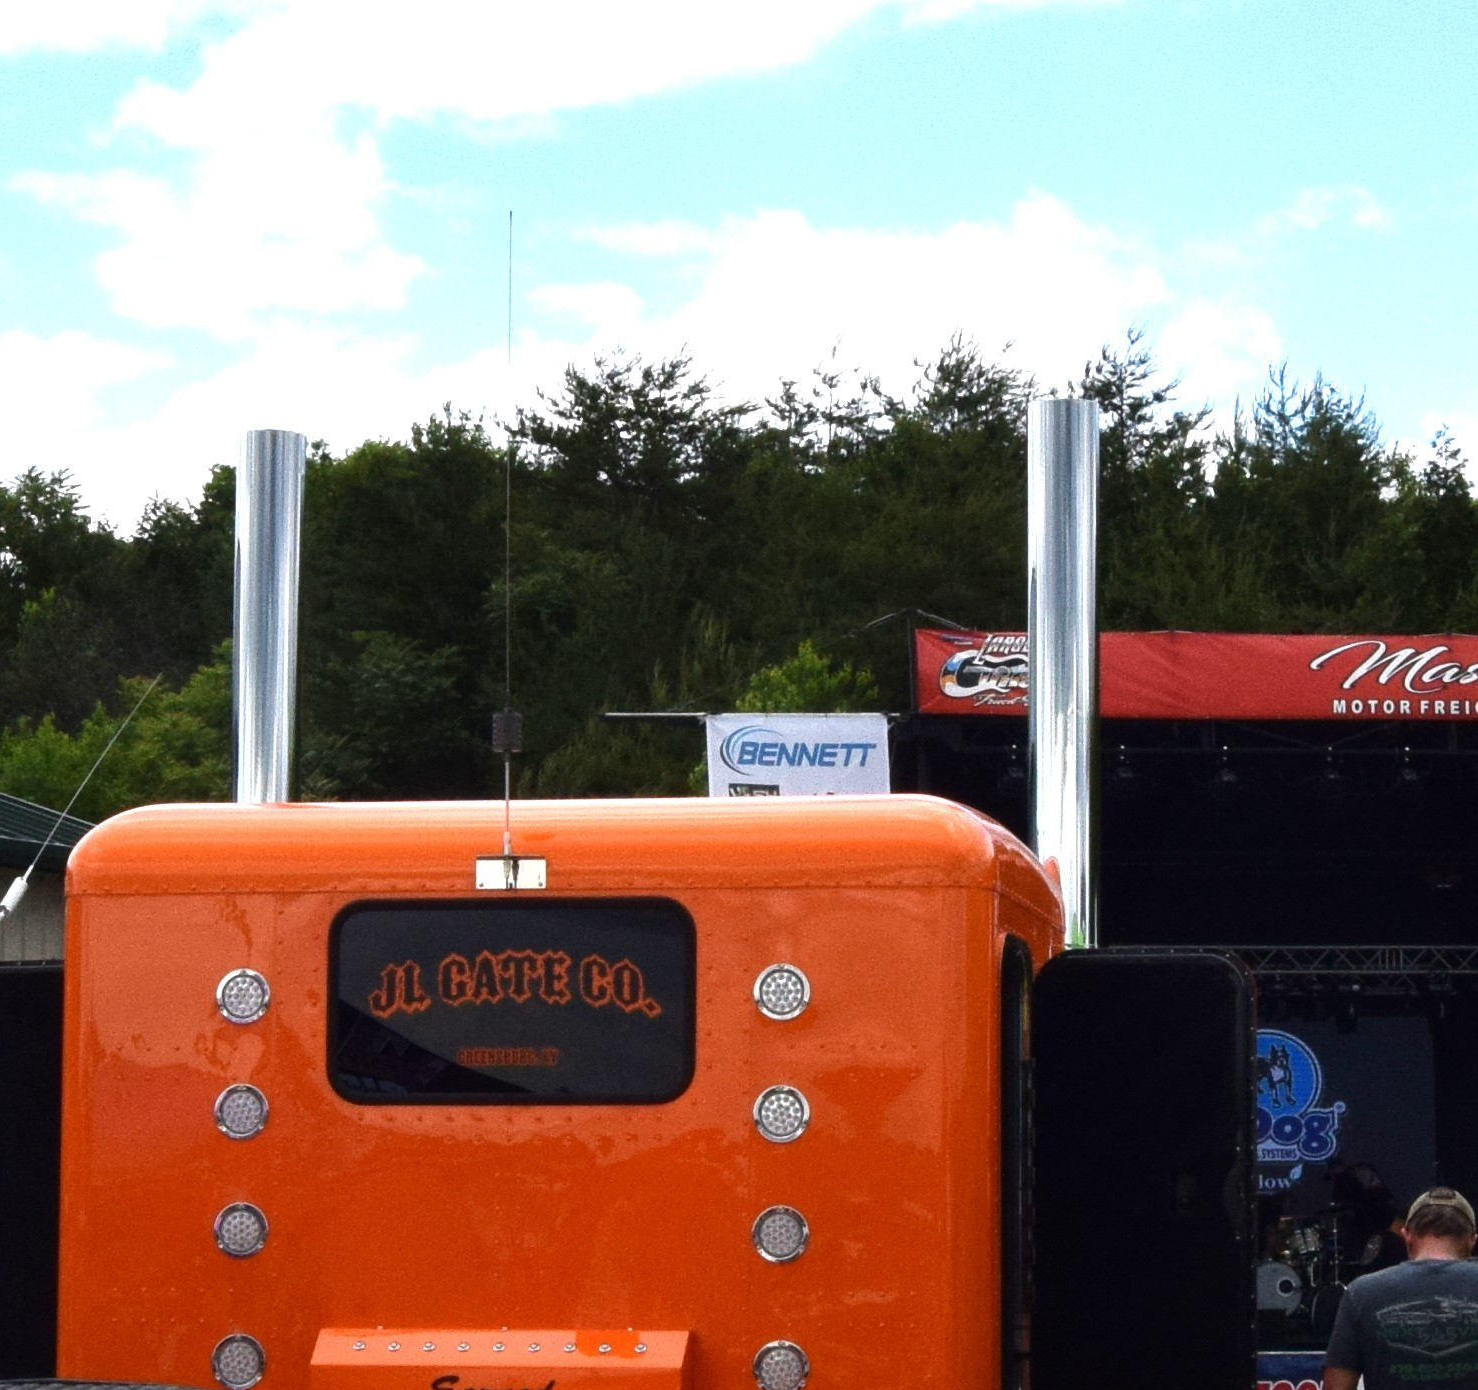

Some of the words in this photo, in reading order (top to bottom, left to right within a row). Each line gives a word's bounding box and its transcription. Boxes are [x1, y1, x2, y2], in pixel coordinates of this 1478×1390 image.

[1332, 699, 1412, 715] MOTOR
[736, 741, 877, 768] BENNETT
[369, 959, 431, 1019] JL
[437, 948, 572, 1006] GATE
[577, 953, 662, 1019] CO.
